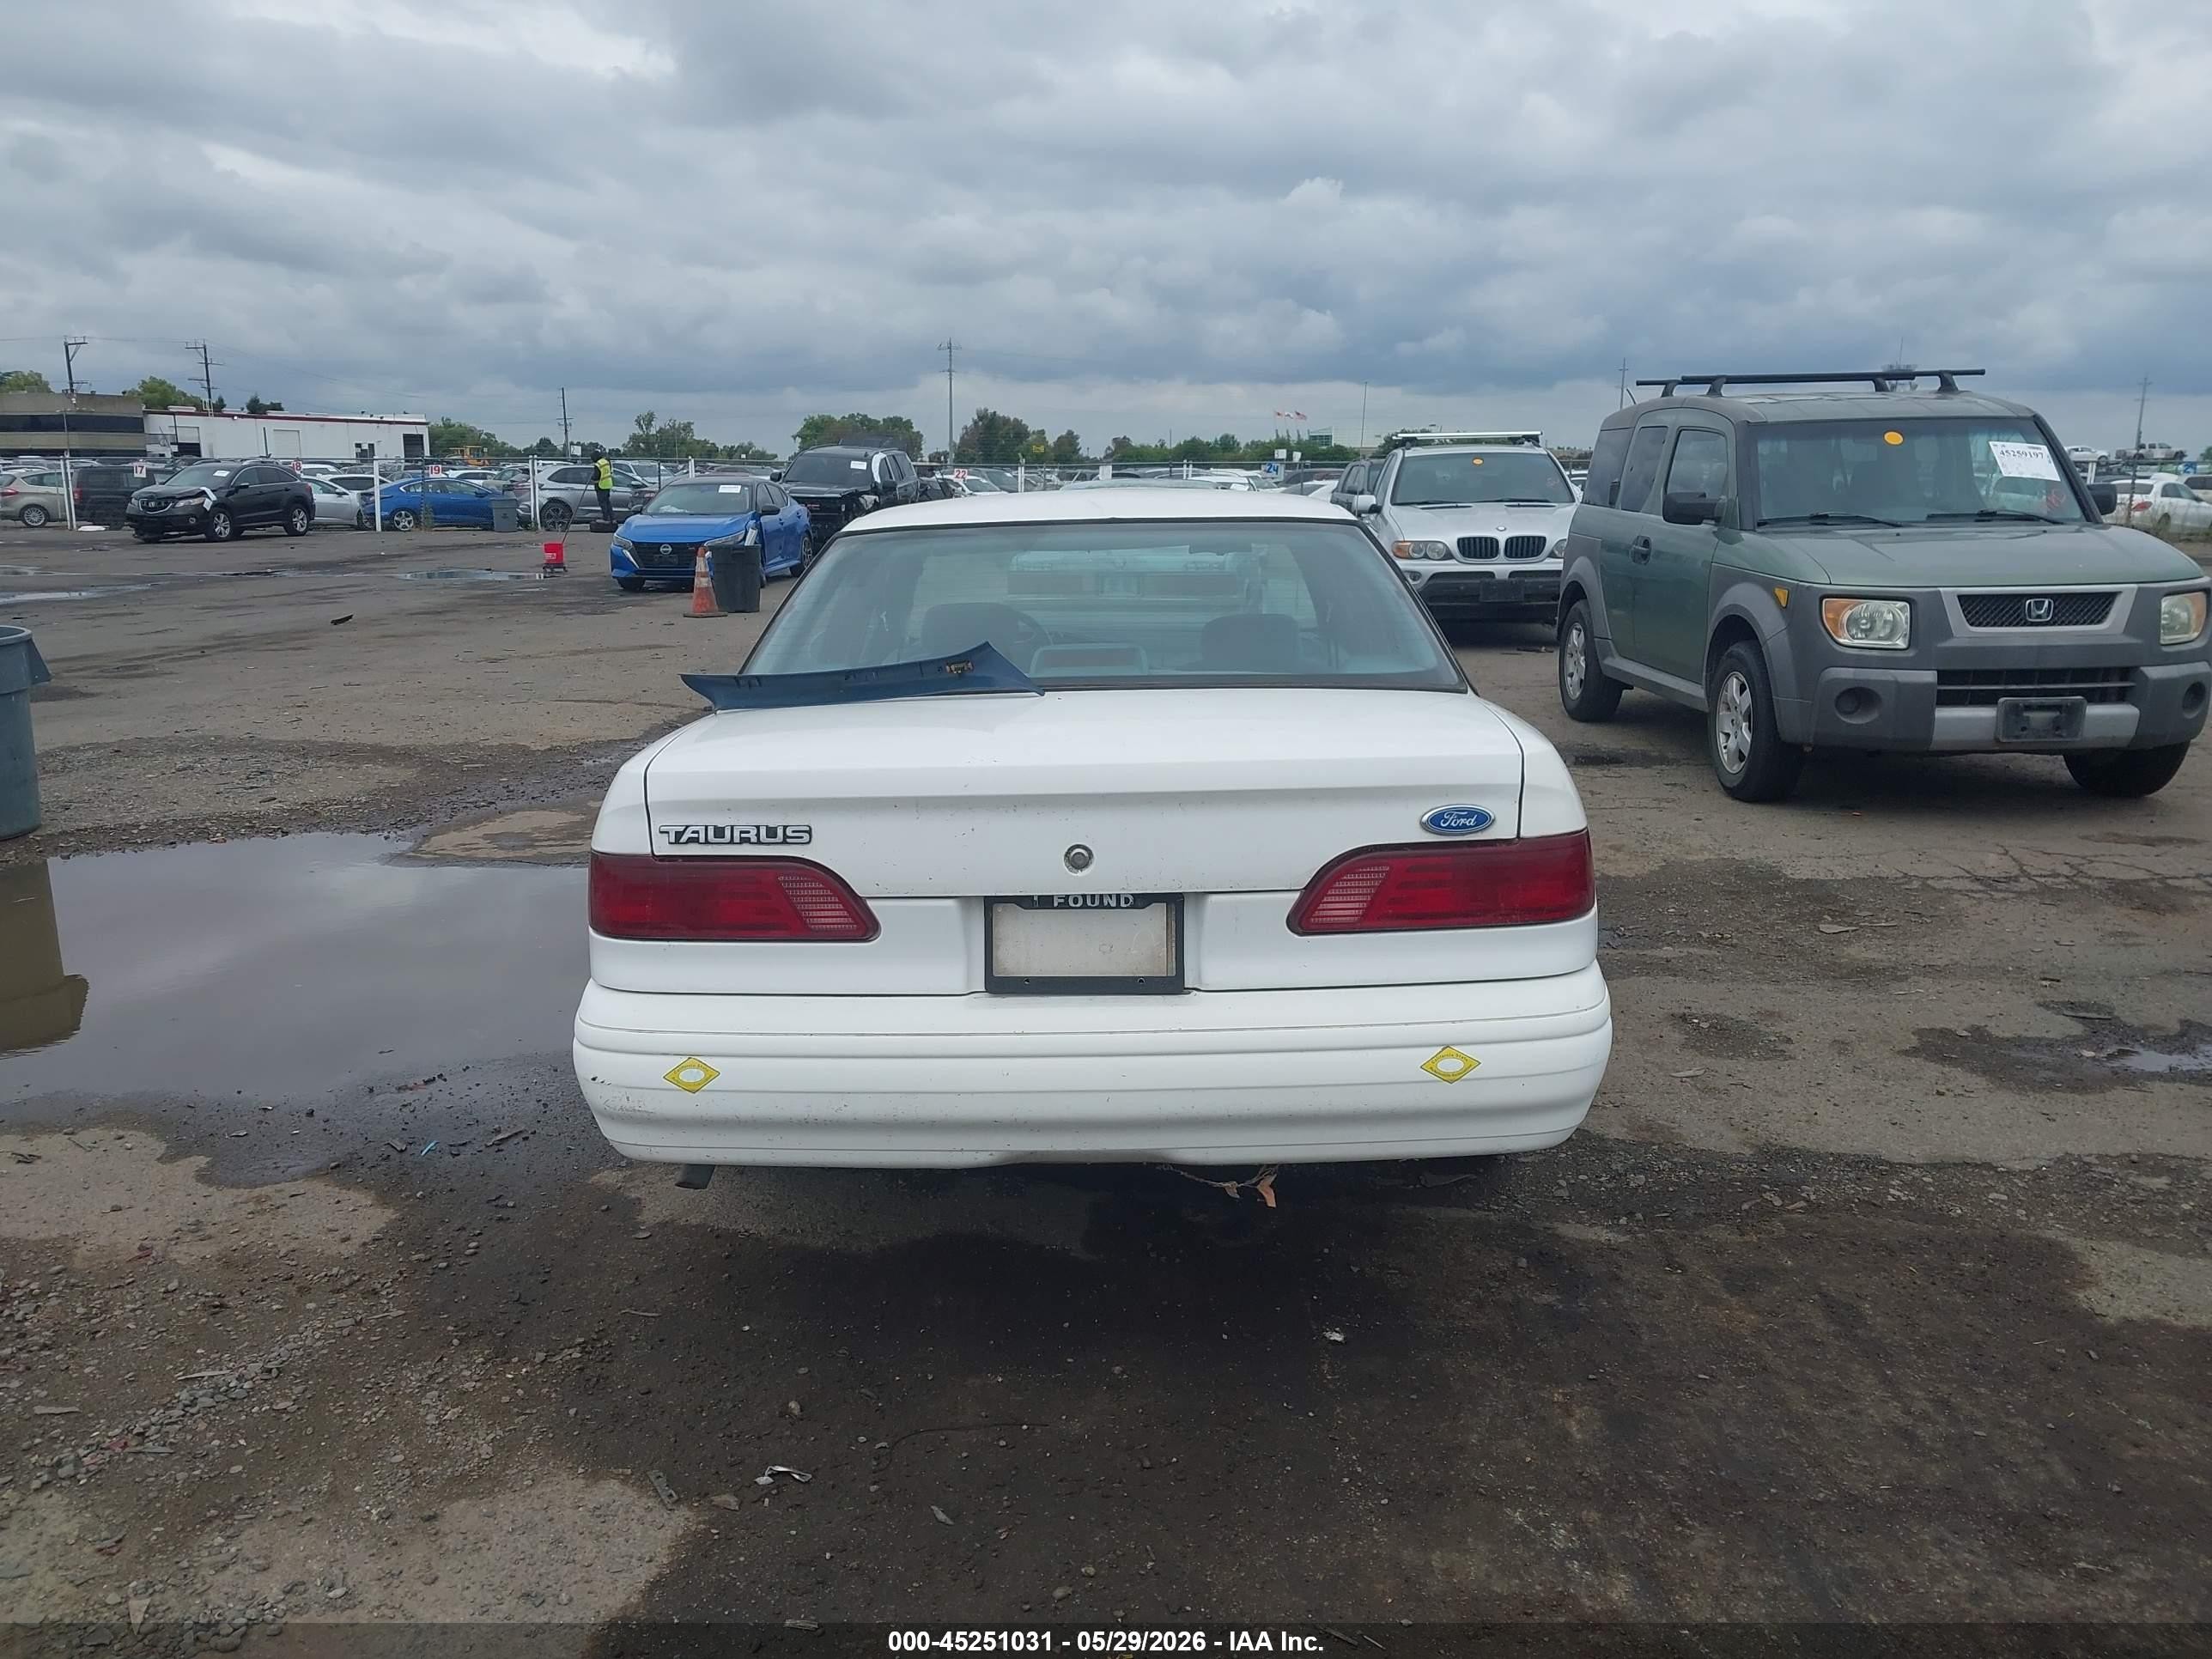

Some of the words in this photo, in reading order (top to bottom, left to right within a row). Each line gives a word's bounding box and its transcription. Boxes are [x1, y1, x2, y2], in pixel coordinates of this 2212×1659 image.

[135, 465, 145, 474] 17
[430, 465, 441, 475] 19
[955, 470, 967, 479] 22
[1267, 463, 1279, 476] 24
[1440, 811, 1478, 827] Ford
[659, 825, 811, 844] TAURUS
[1053, 893, 1134, 908] FOUND
